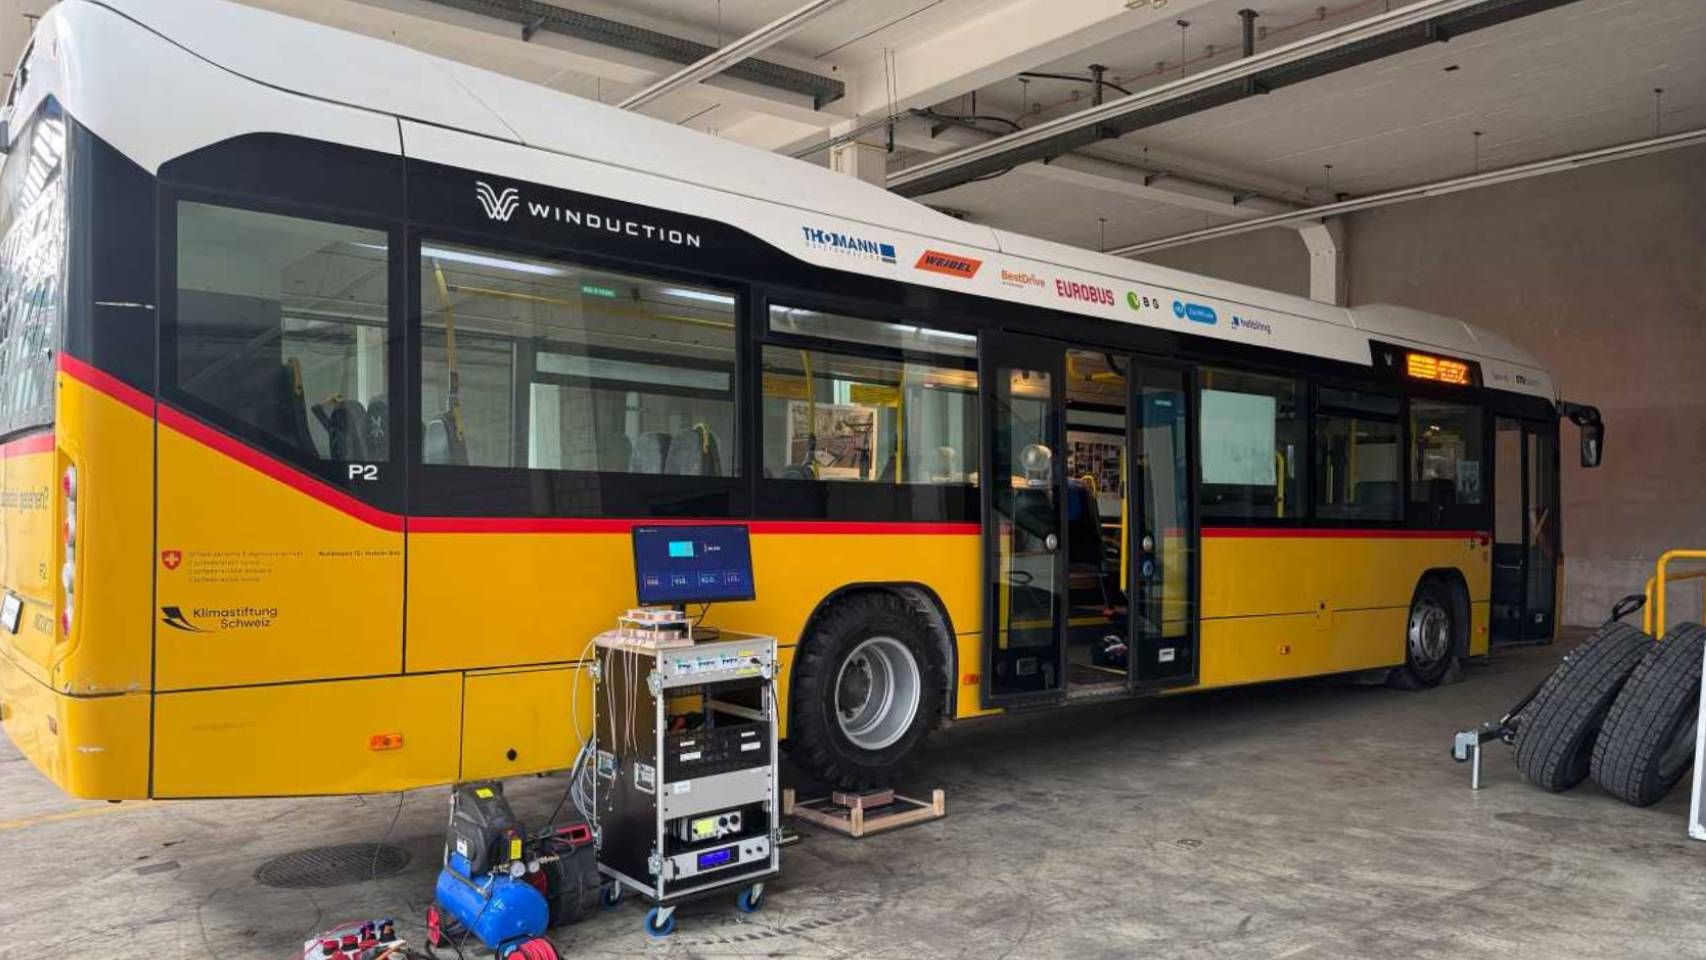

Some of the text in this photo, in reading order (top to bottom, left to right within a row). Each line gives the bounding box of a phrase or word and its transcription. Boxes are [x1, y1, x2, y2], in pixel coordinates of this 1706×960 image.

[528, 202, 701, 247] WINDUCTION
[802, 226, 879, 255] THOMANN
[925, 255, 972, 272] WEIBEL
[1001, 270, 1045, 288] BestDrive
[1056, 279, 1115, 306] EUROBUS
[348, 464, 379, 481] P2
[192, 605, 278, 619] Klimastiftung
[220, 618, 271, 630] Schweiz
